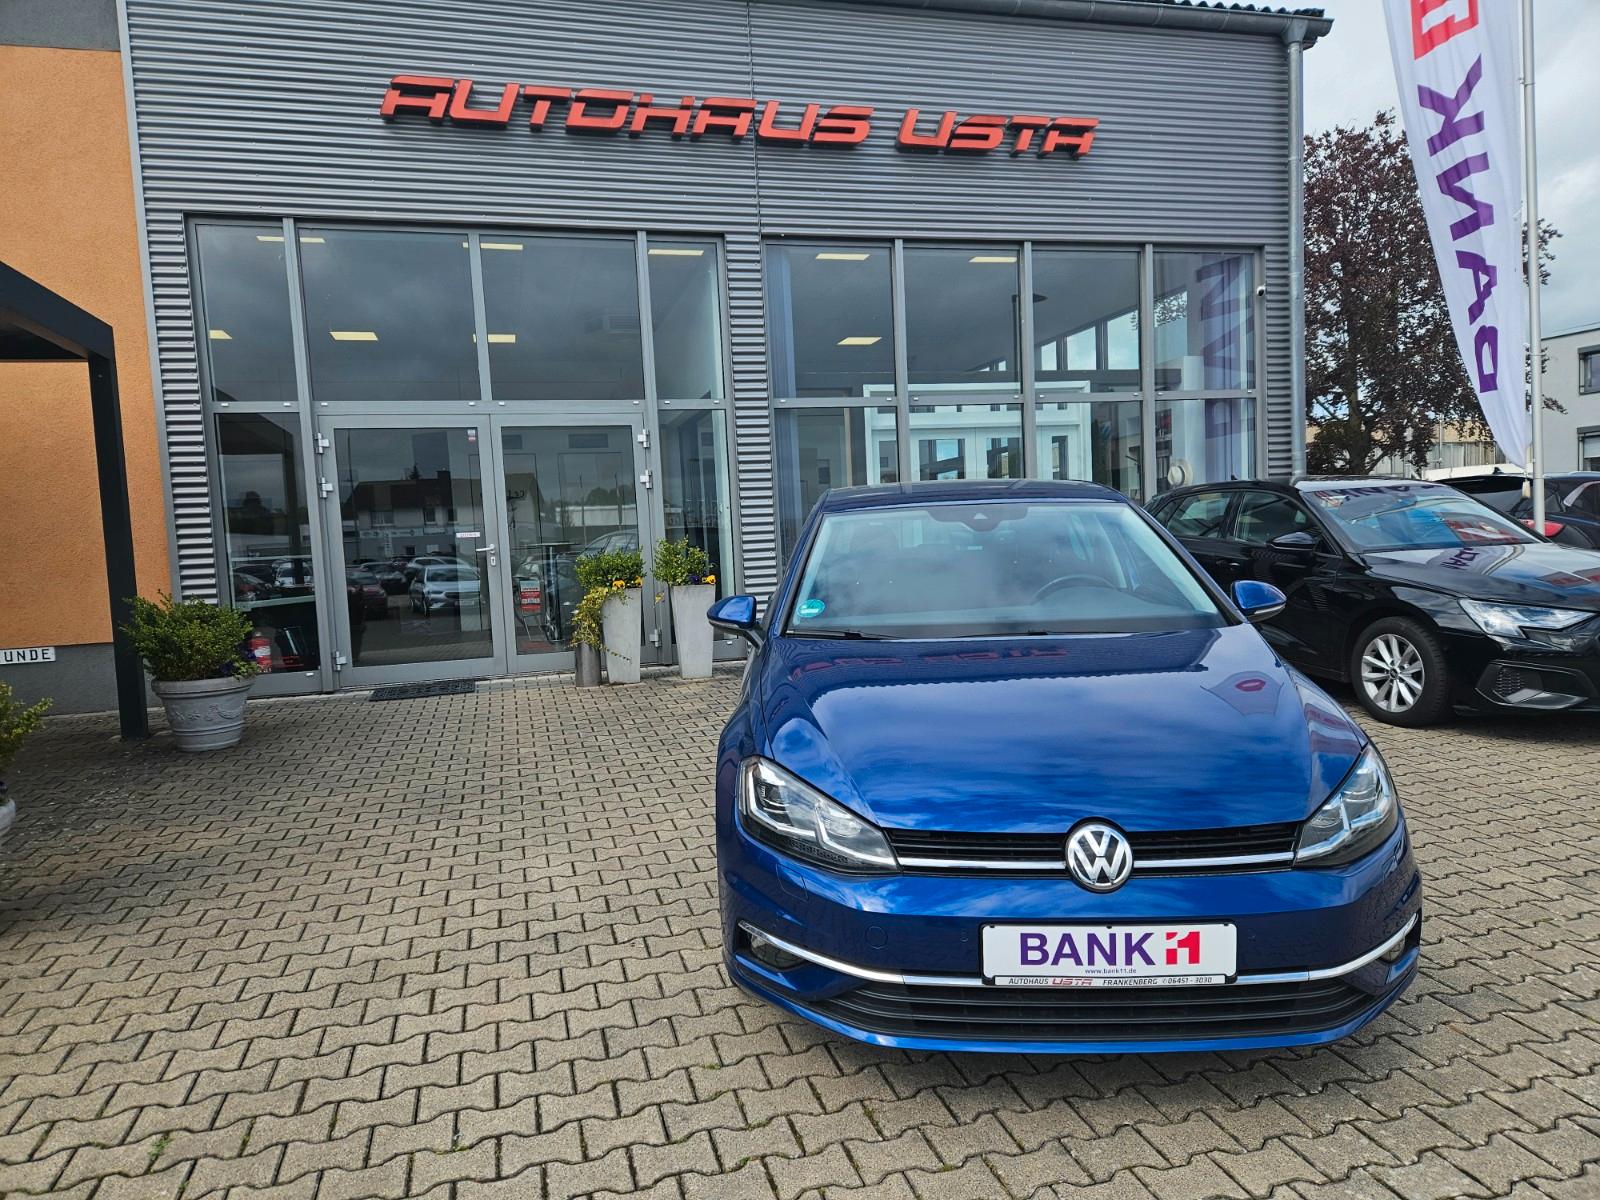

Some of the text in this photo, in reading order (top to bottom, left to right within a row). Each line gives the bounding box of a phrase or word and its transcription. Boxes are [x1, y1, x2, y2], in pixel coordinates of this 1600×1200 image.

[379, 74, 1100, 161] AUTOHAUS USTA
[1019, 932, 1156, 966] BANK
[1008, 977, 1049, 985] AUTOHAUS
[1052, 977, 1093, 986] USTA
[1102, 978, 1158, 986] FRANKENBERG
[1084, 967, 1137, 975] www.bank11.de
